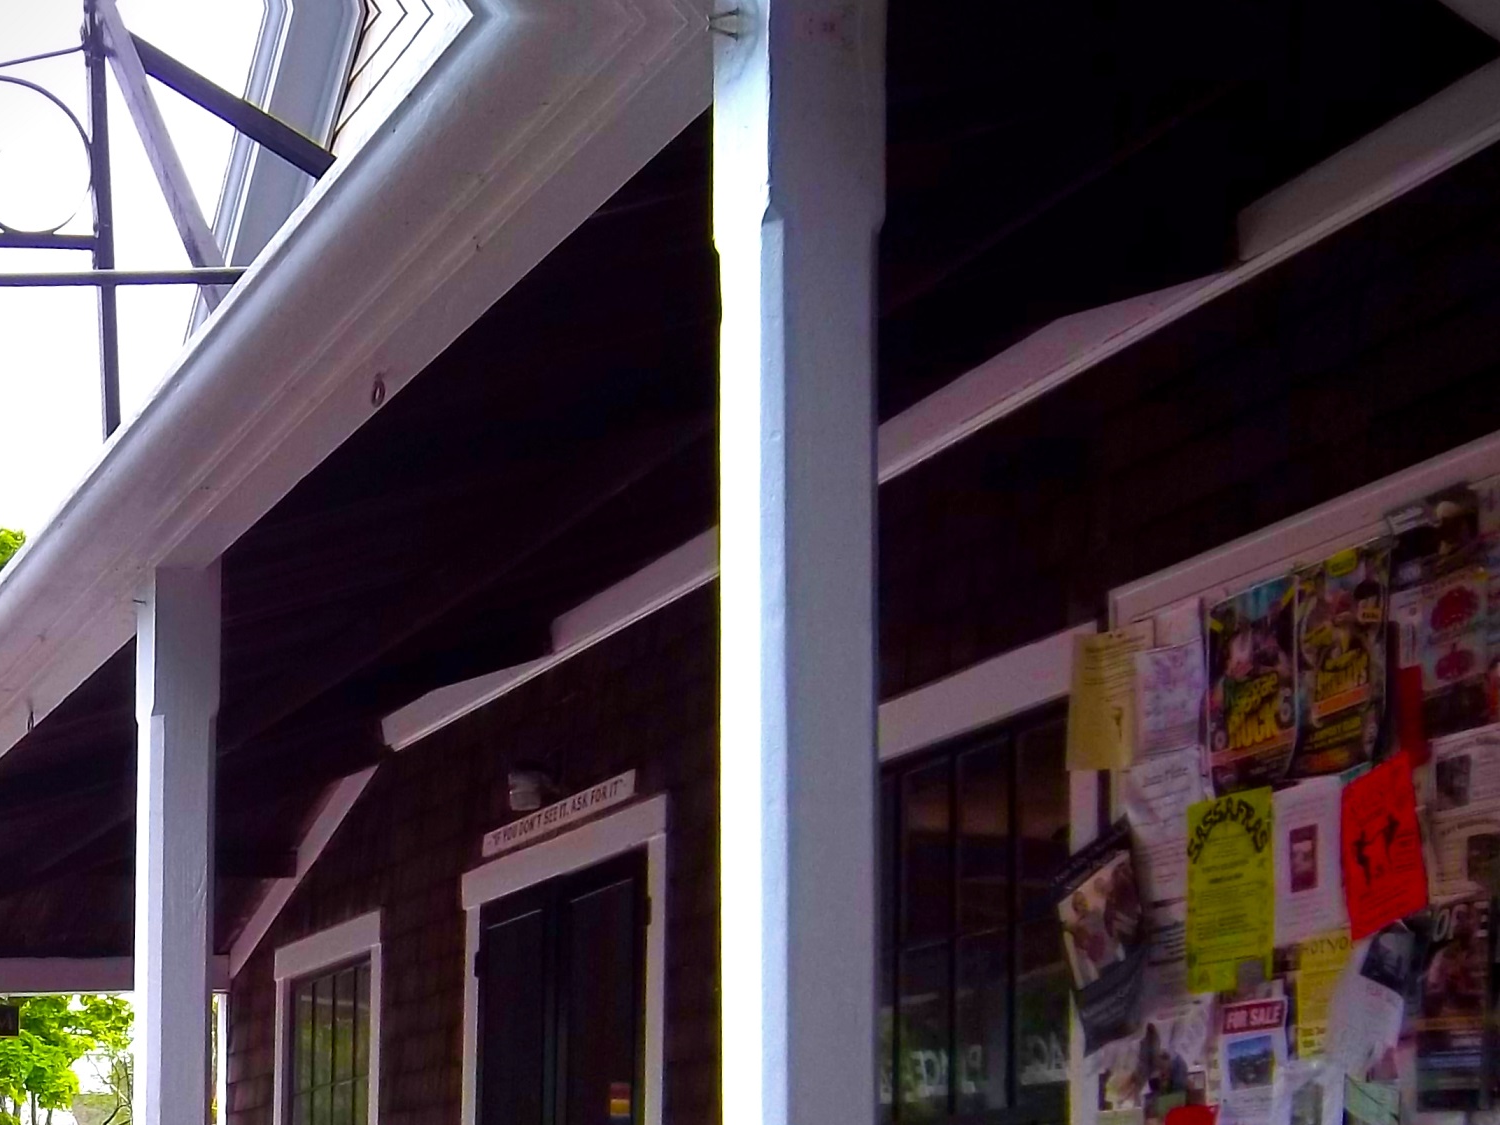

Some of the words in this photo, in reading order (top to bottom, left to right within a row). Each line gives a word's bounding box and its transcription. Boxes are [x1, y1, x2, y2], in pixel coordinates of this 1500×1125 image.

[543, 807, 558, 825] SEE
[570, 794, 589, 814] ASK
[590, 786, 607, 806] FOR
[1226, 1009, 1248, 1030] FOR
[1250, 1002, 1281, 1027] SALE
